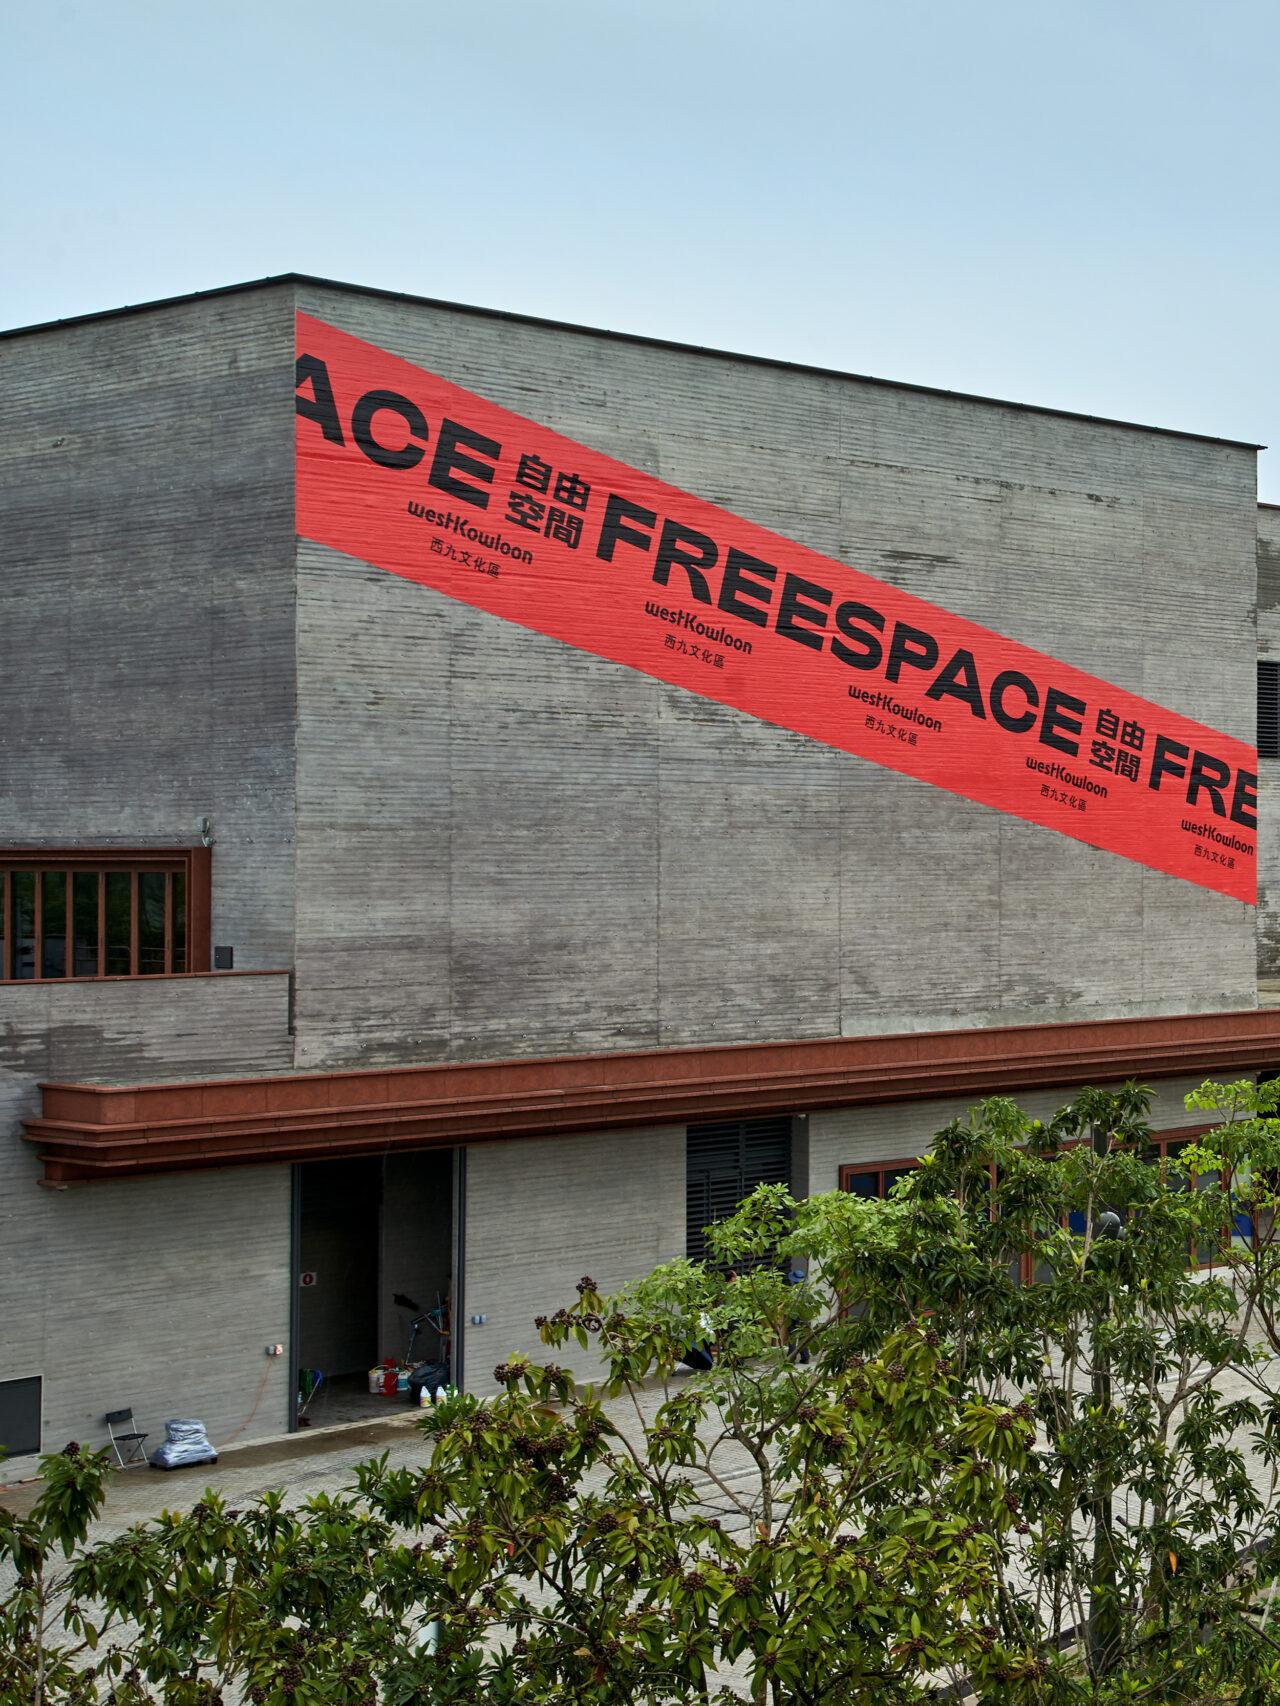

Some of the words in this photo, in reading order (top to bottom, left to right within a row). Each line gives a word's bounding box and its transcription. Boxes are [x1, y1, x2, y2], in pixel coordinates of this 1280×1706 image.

[515, 453, 591, 513] 自由
[504, 490, 584, 549] 空間
[430, 536, 501, 579] 西九文化區
[596, 493, 1086, 757] FREESPACE
[664, 633, 726, 669] 西九文化區
[865, 715, 918, 747] 西九文化區
[1095, 708, 1145, 752] 自由
[1089, 739, 1141, 783] 空間
[1149, 734, 1257, 830] FRE
[1040, 783, 1088, 813] 西九文化區
